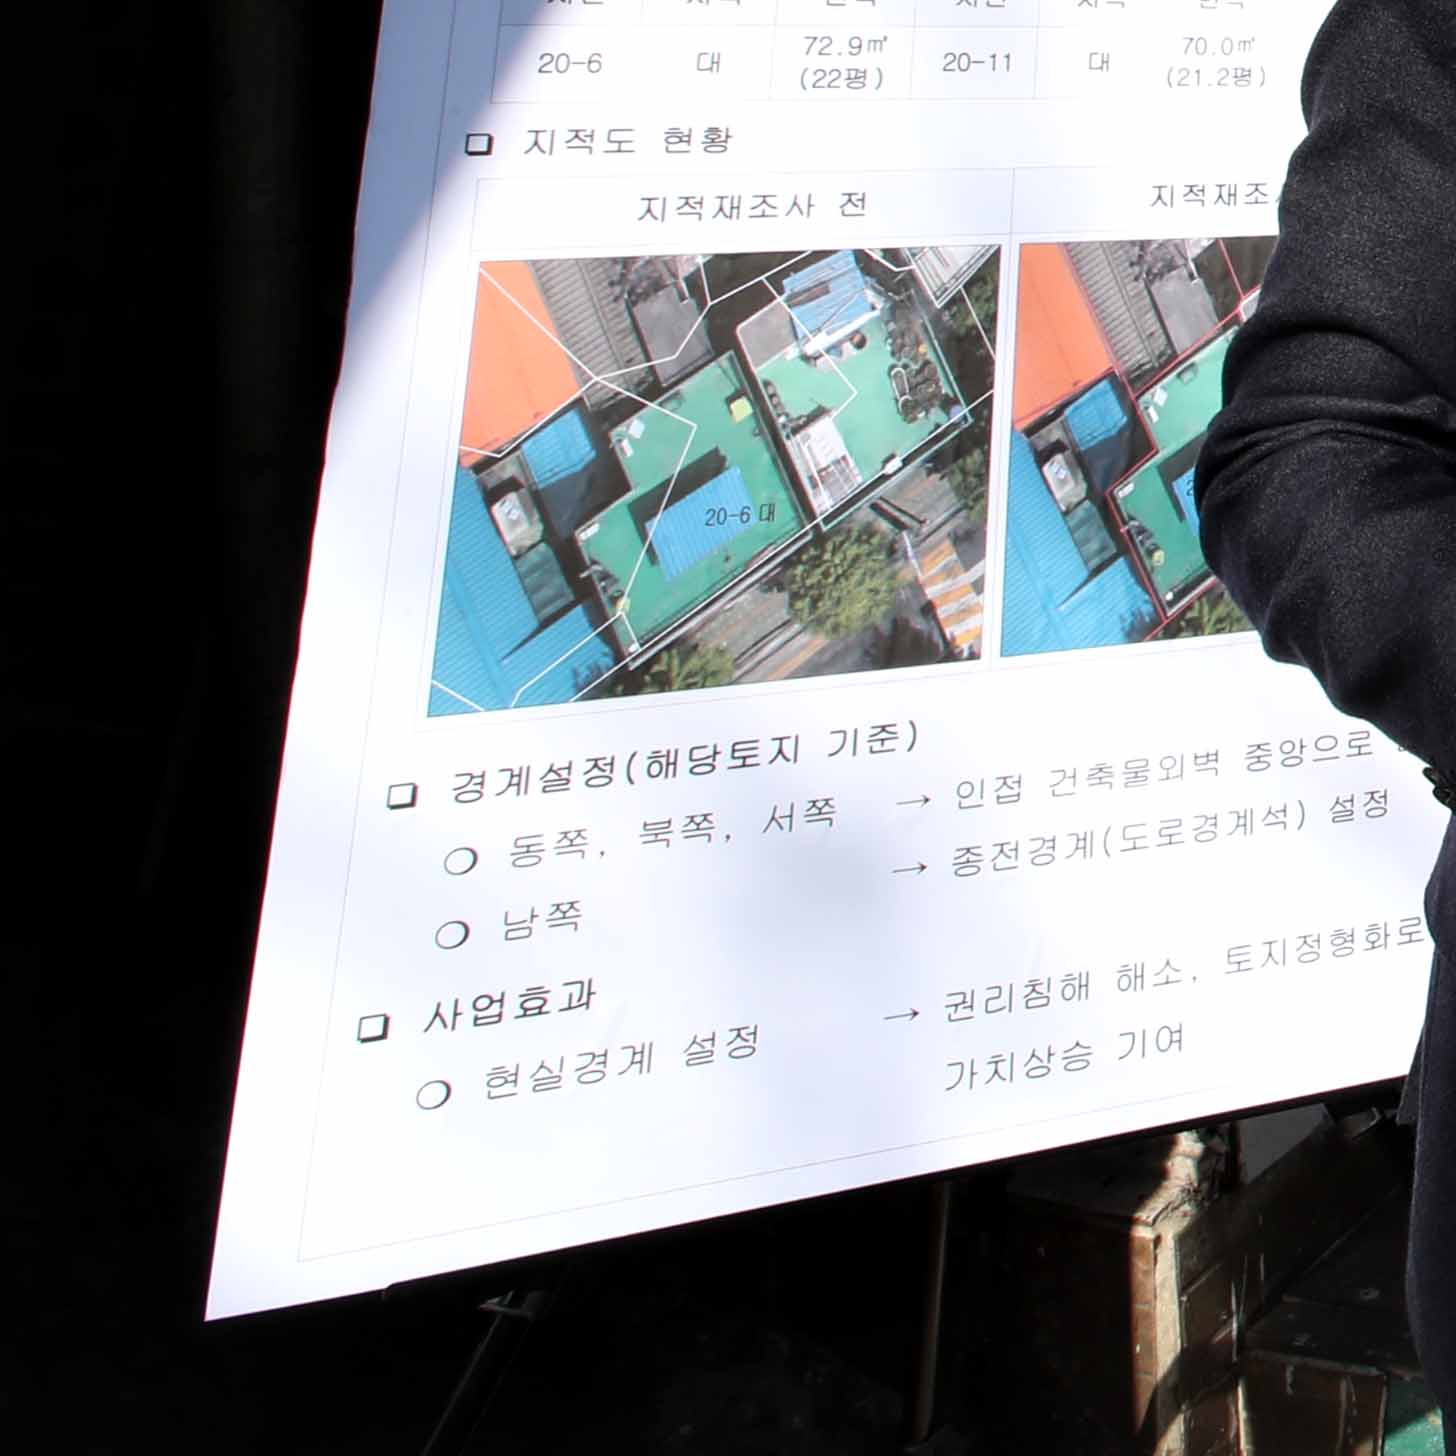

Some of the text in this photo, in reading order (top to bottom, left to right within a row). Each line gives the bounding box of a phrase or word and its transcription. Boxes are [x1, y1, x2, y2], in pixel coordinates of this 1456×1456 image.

[537, 52, 602, 74] 20-6
[696, 51, 721, 73] 대
[941, 51, 1011, 73] 20-11
[1088, 51, 1110, 73] 대
[1166, 66, 1266, 89] (21.2평)
[800, 67, 883, 91] (22평)
[523, 126, 733, 156] 지적도 현황
[637, 191, 866, 223] 지적재조사 전
[1151, 182, 1281, 210] 지적재조
[705, 504, 775, 527] 20-6 대
[452, 719, 917, 807] 경계설정(해당토지 기준)
[956, 730, 1374, 810] 인접 건축물외벽 중앙으로
[509, 797, 837, 869] 동쪽, 북쪽, 서쪽
[951, 788, 1388, 878] 종전경계(도로경계석) 설정
[503, 900, 582, 942] 남쪽
[944, 915, 1426, 1023] 권리침해 해소, 토지정형화로
[423, 978, 597, 1033] 사업효과
[485, 1023, 758, 1101] 현실경계 설정
[945, 1023, 1183, 1092] 가치상승 기여
